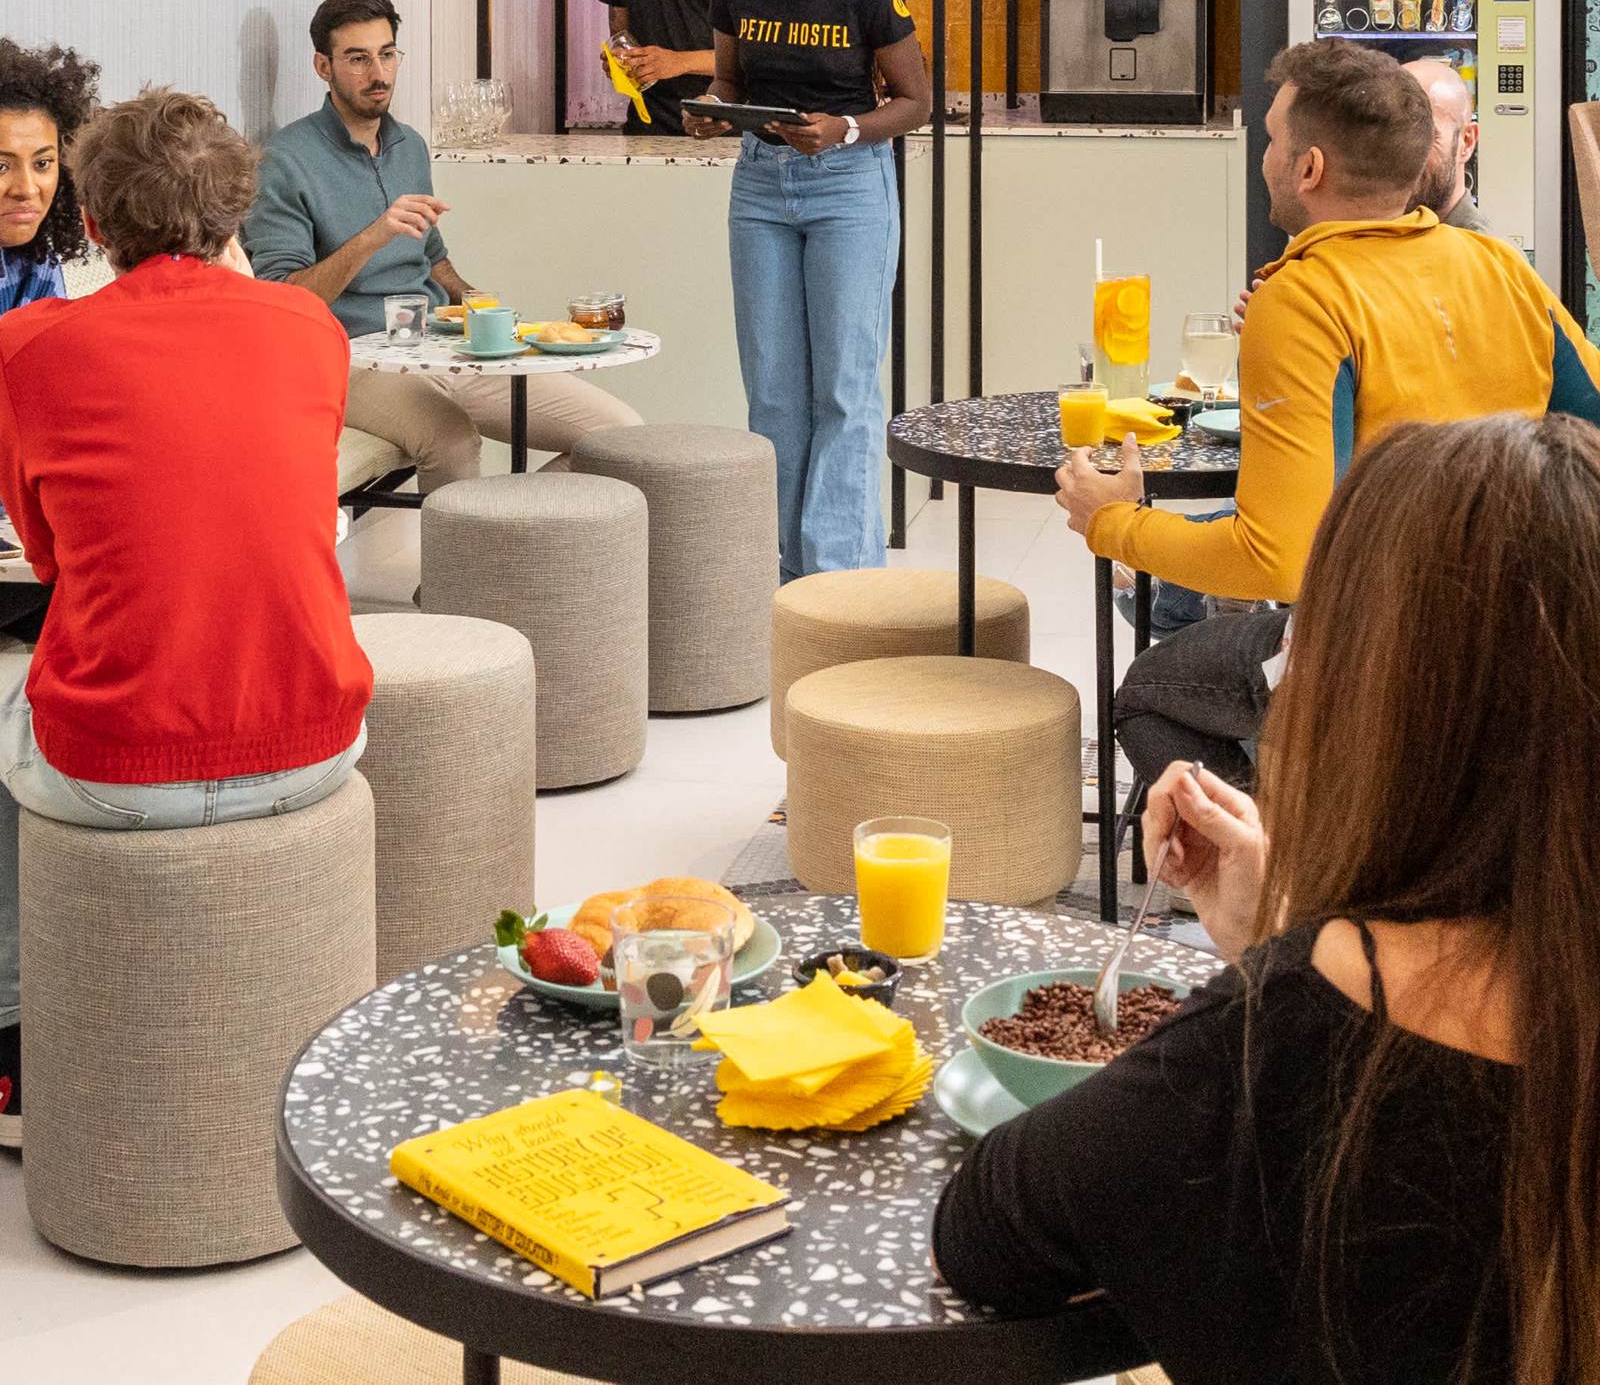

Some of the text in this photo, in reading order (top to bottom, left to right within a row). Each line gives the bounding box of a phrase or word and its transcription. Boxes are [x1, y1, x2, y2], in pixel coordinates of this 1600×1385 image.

[738, 18, 851, 48] PETIT HOSTEL
[473, 1124, 635, 1189] HISTORY OF
[505, 1144, 673, 1207] EDUCATION
